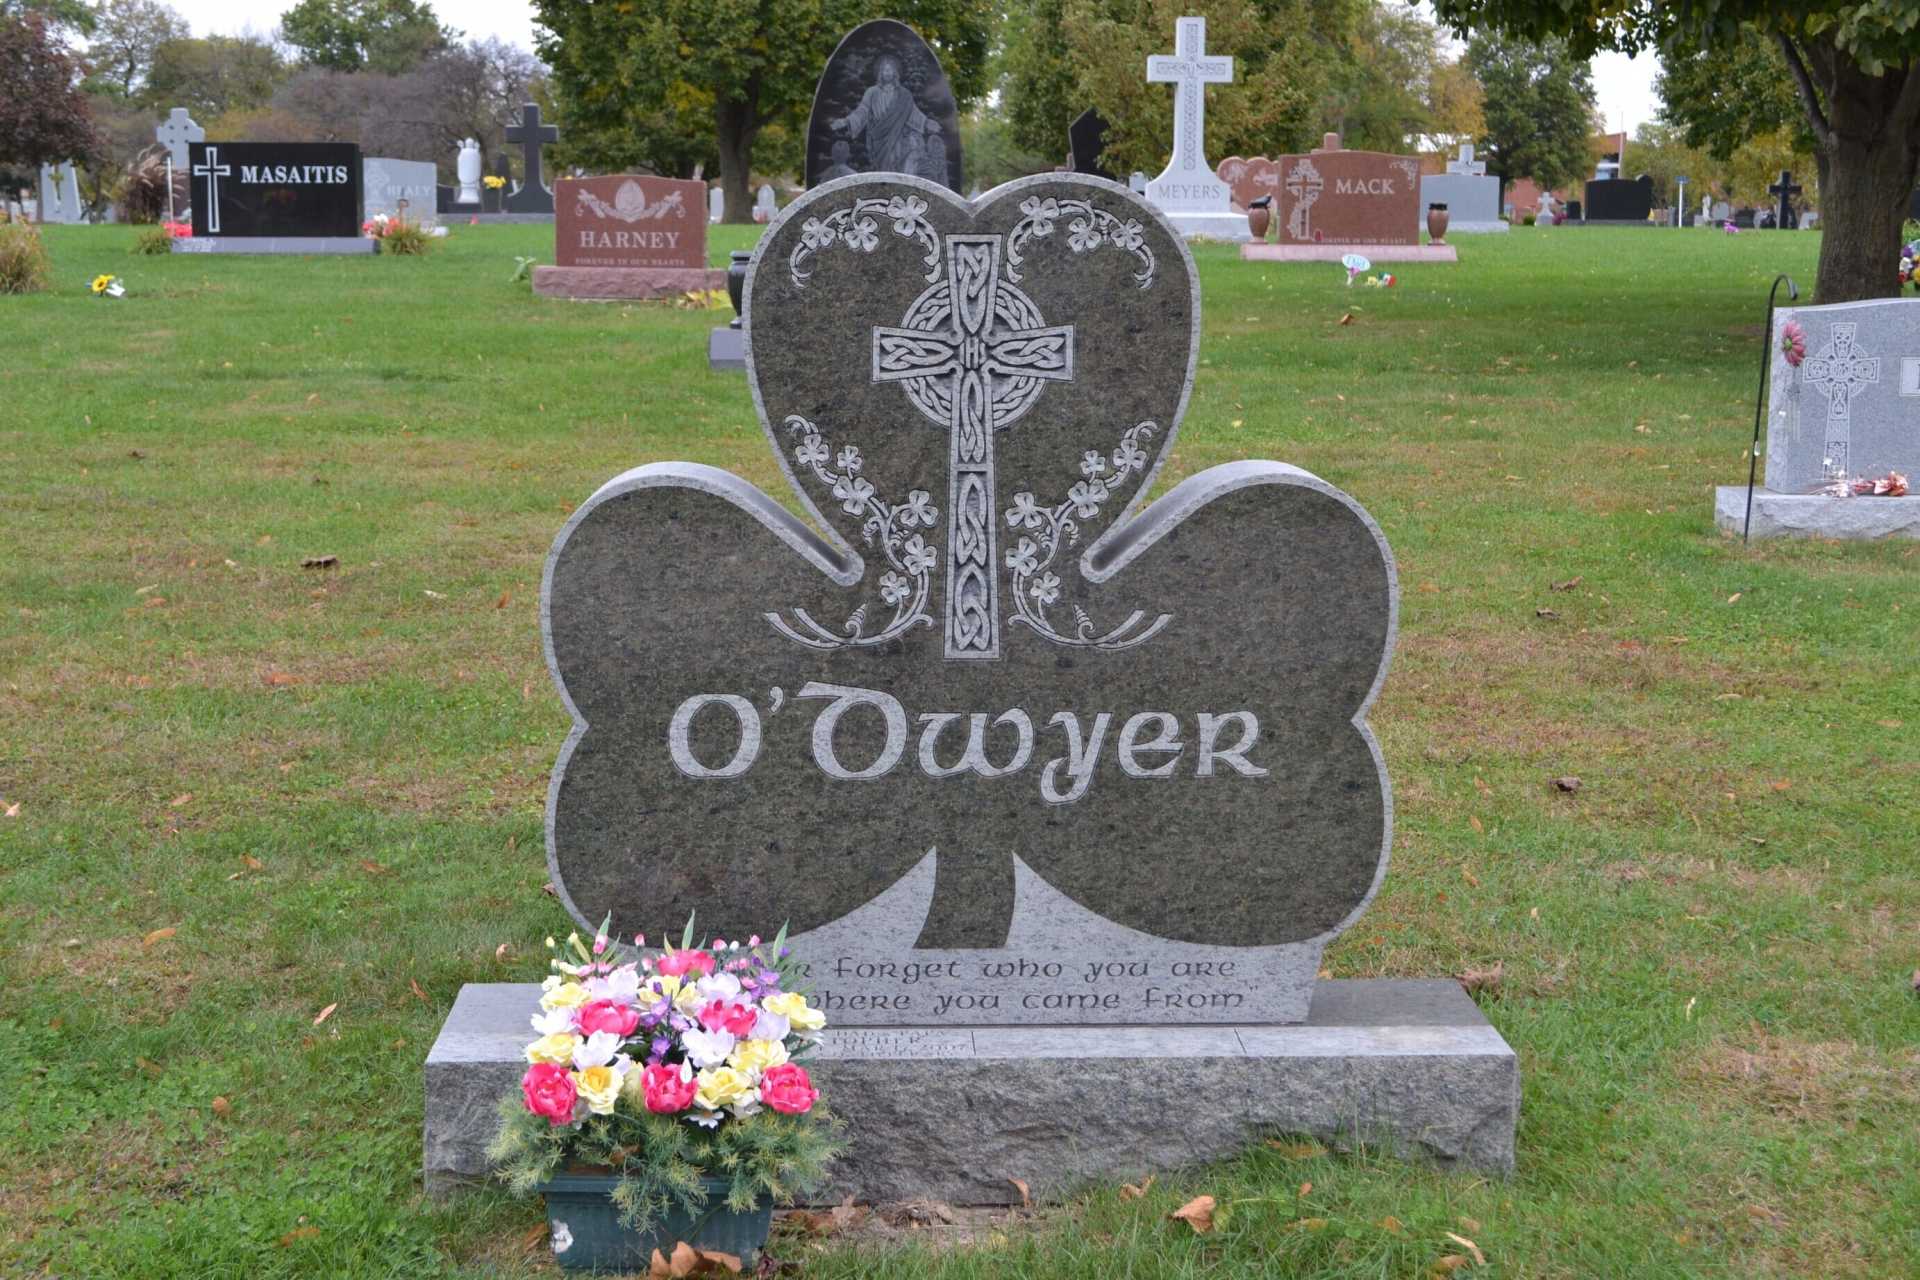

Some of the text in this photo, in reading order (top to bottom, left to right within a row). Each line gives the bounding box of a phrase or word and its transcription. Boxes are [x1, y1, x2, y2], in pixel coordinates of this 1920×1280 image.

[241, 165, 348, 184] MASAITIS
[1159, 183, 1220, 200] MEYERS
[1335, 178, 1395, 194] MACK
[579, 230, 681, 248] HARNEY
[833, 956, 961, 984] forget
[982, 958, 1062, 977] who
[1084, 961, 1148, 983] you
[1170, 961, 1236, 977] are
[933, 993, 999, 1016] you
[1022, 993, 1121, 1009] came
